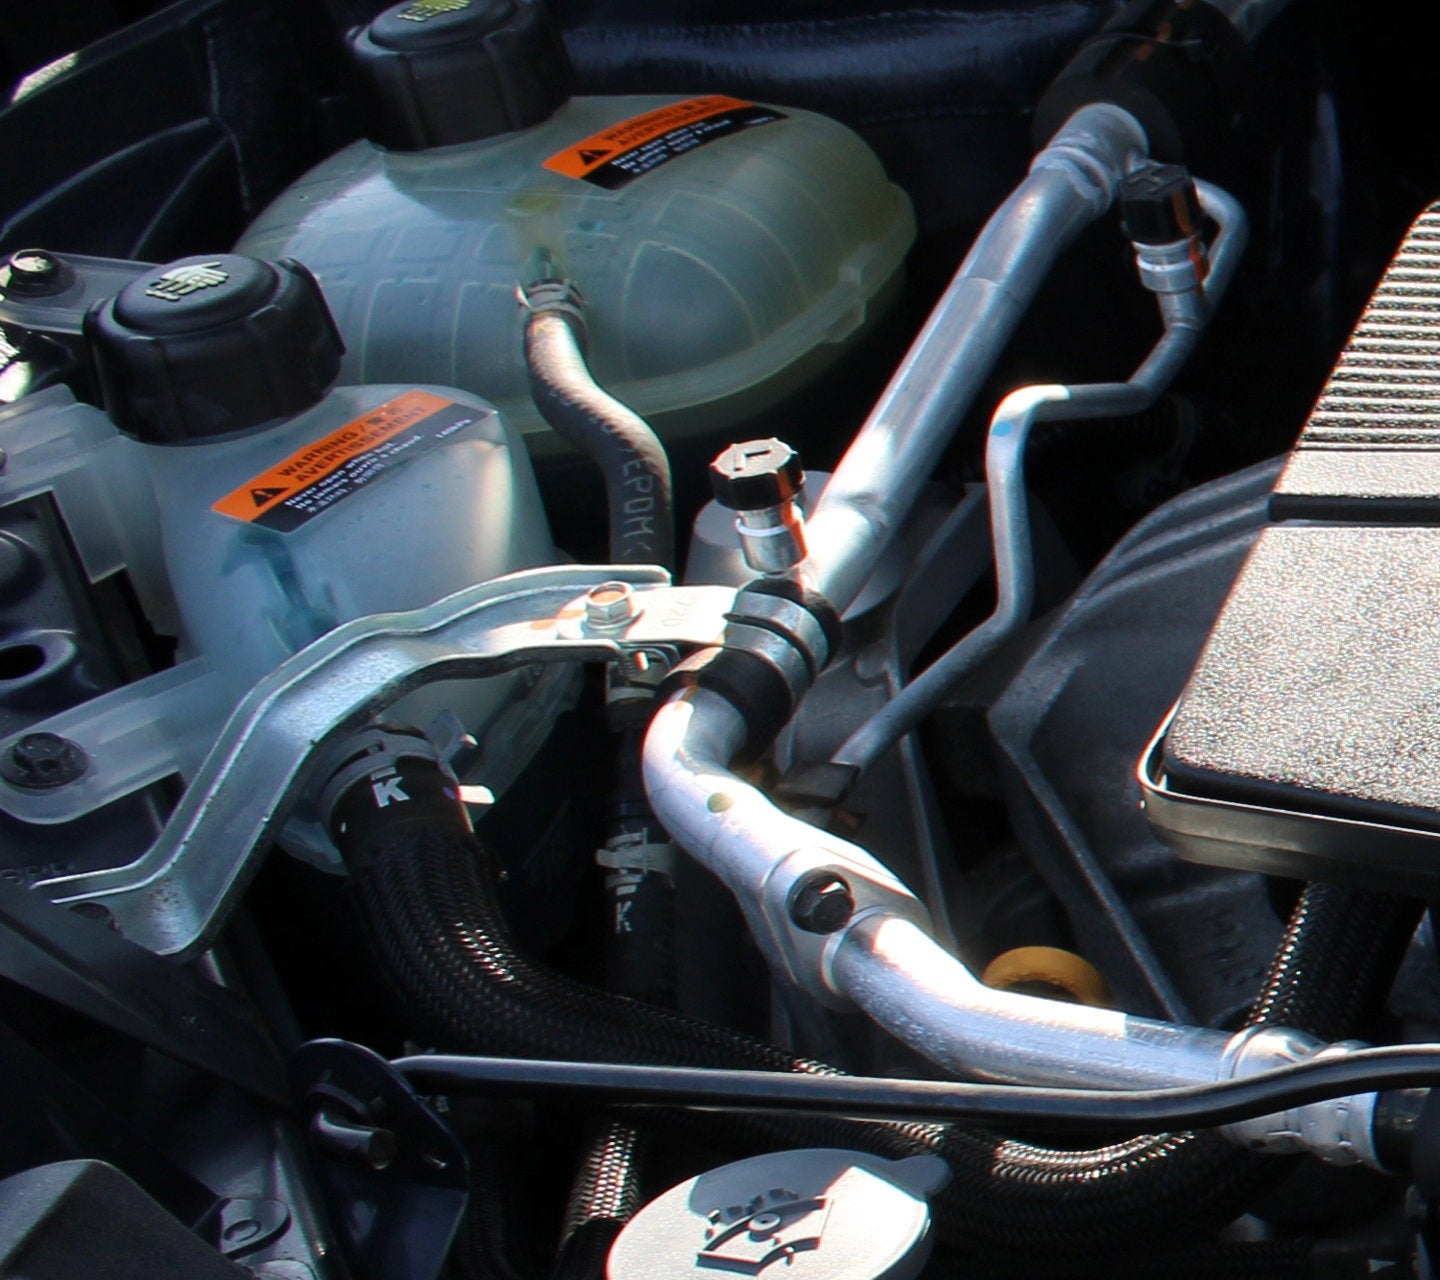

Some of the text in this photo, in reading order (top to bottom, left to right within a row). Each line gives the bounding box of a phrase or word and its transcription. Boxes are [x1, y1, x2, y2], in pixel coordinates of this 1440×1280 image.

[277, 431, 359, 477] WARNING
[296, 406, 427, 483] AVERTISSEMENT
[371, 776, 411, 808] K
